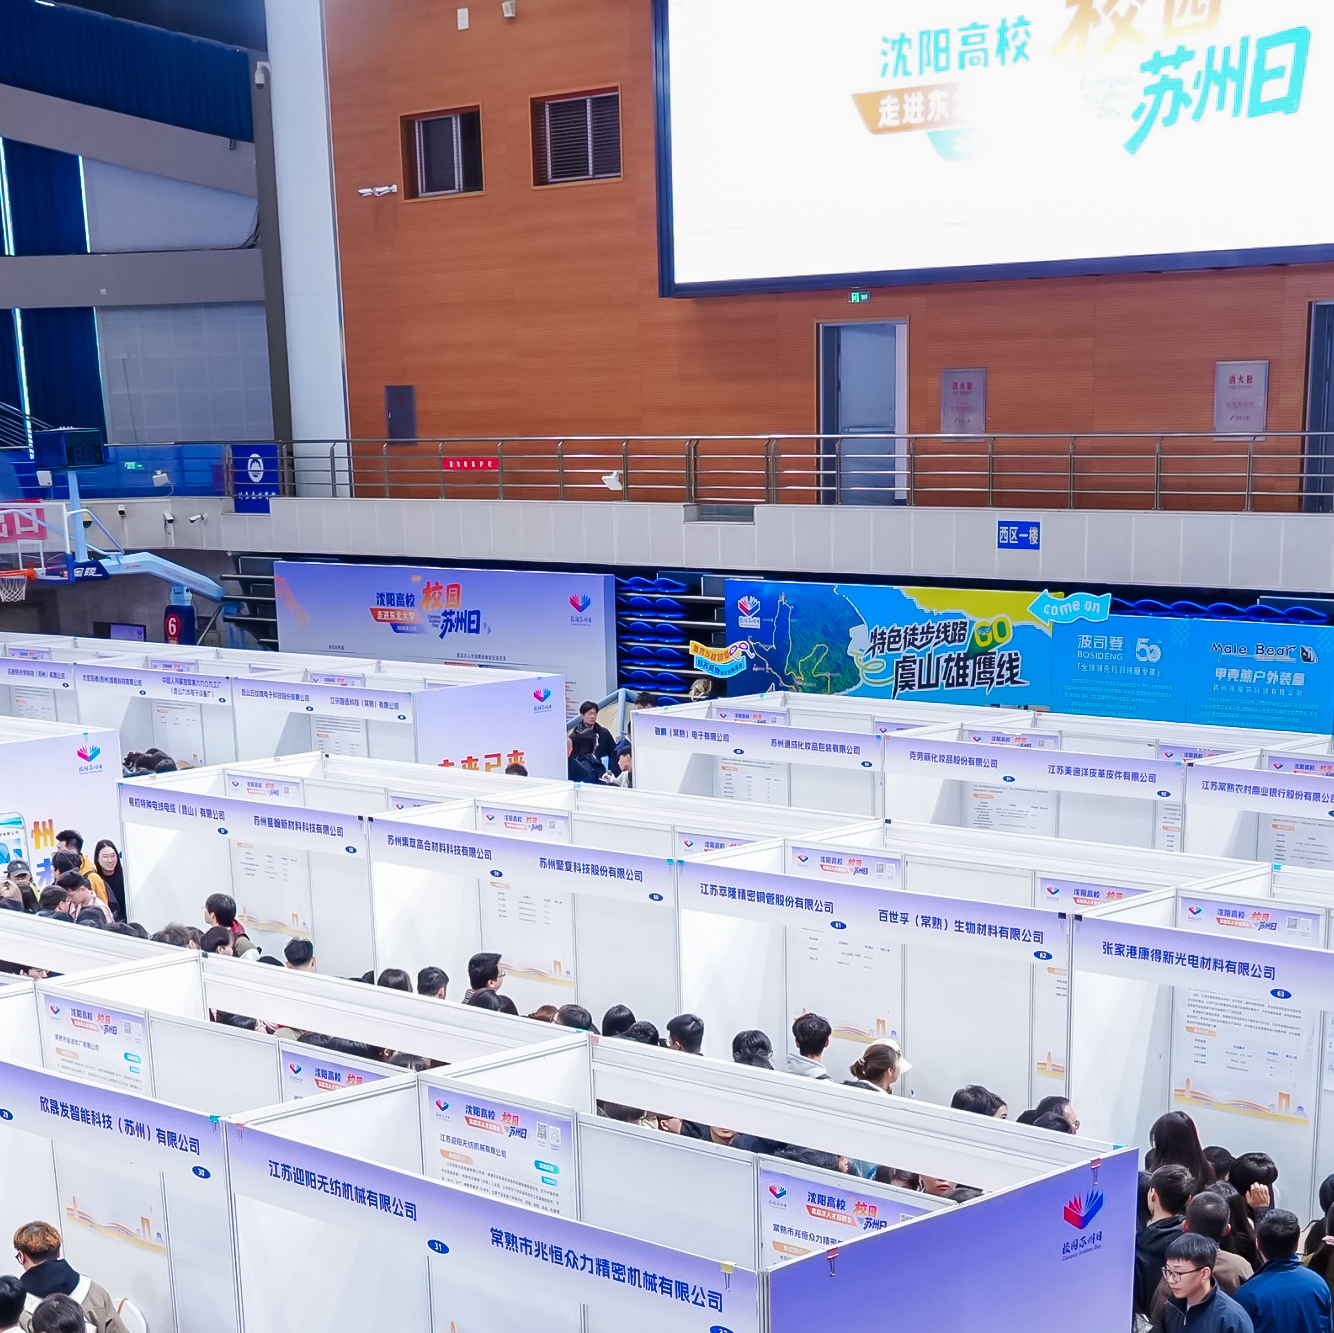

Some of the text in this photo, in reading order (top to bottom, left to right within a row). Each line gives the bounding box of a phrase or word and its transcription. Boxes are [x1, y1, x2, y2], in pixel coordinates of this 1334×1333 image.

[879, 14, 1032, 78] 沈阳高校
[1123, 25, 1312, 156] 苏州日
[1229, 374, 1253, 384] 消火栓
[999, 526, 1038, 545] 西区一楼
[376, 592, 415, 608] 沈阳高校
[419, 581, 460, 612] 校园
[377, 610, 416, 622] 走进东北大学
[1043, 599, 1100, 615] come on
[168, 618, 177, 634] 6
[439, 609, 481, 639] 苏州日
[866, 620, 967, 656] 特色徒步线路
[1077, 634, 1124, 652] 波司登
[1077, 651, 1123, 661] BOSIDENG
[1210, 642, 1297, 661] Male Bear
[893, 649, 1029, 700] 虞山雄鹰线
[539, 857, 643, 883] 苏州聚复科技股份有限公司
[700, 882, 834, 914] 江苏萃隆精密铜管股份有限公司
[1073, 888, 1100, 898] 沈阳高校
[1216, 908, 1245, 919] 沈阳高校
[878, 909, 1044, 944] 百世孚（常熟）生物材料有限公司
[1258, 921, 1277, 931] 苏州日
[1102, 941, 1276, 981] 张家港康得新光电材料有限公司
[314, 1067, 342, 1084] 沈阳高校
[465, 1103, 496, 1121] 沈阳高校
[501, 1111, 520, 1125] 校园
[39, 1096, 201, 1156] 欣晟发智能科技（苏州）有限公司
[508, 1125, 528, 1140] 苏州日
[439, 1132, 507, 1159] 江苏迎阳无纺机械有限公司
[268, 1158, 418, 1222] 江苏迎阳无纺机械有限公司
[806, 1191, 847, 1212] 沈阳高校
[853, 1202, 879, 1219] 校园
[435, 1240, 442, 1248] 31
[1062, 1230, 1103, 1255] 校园苏州日
[489, 1226, 724, 1313] 常熟市兆恒众力精密机械有限公司
